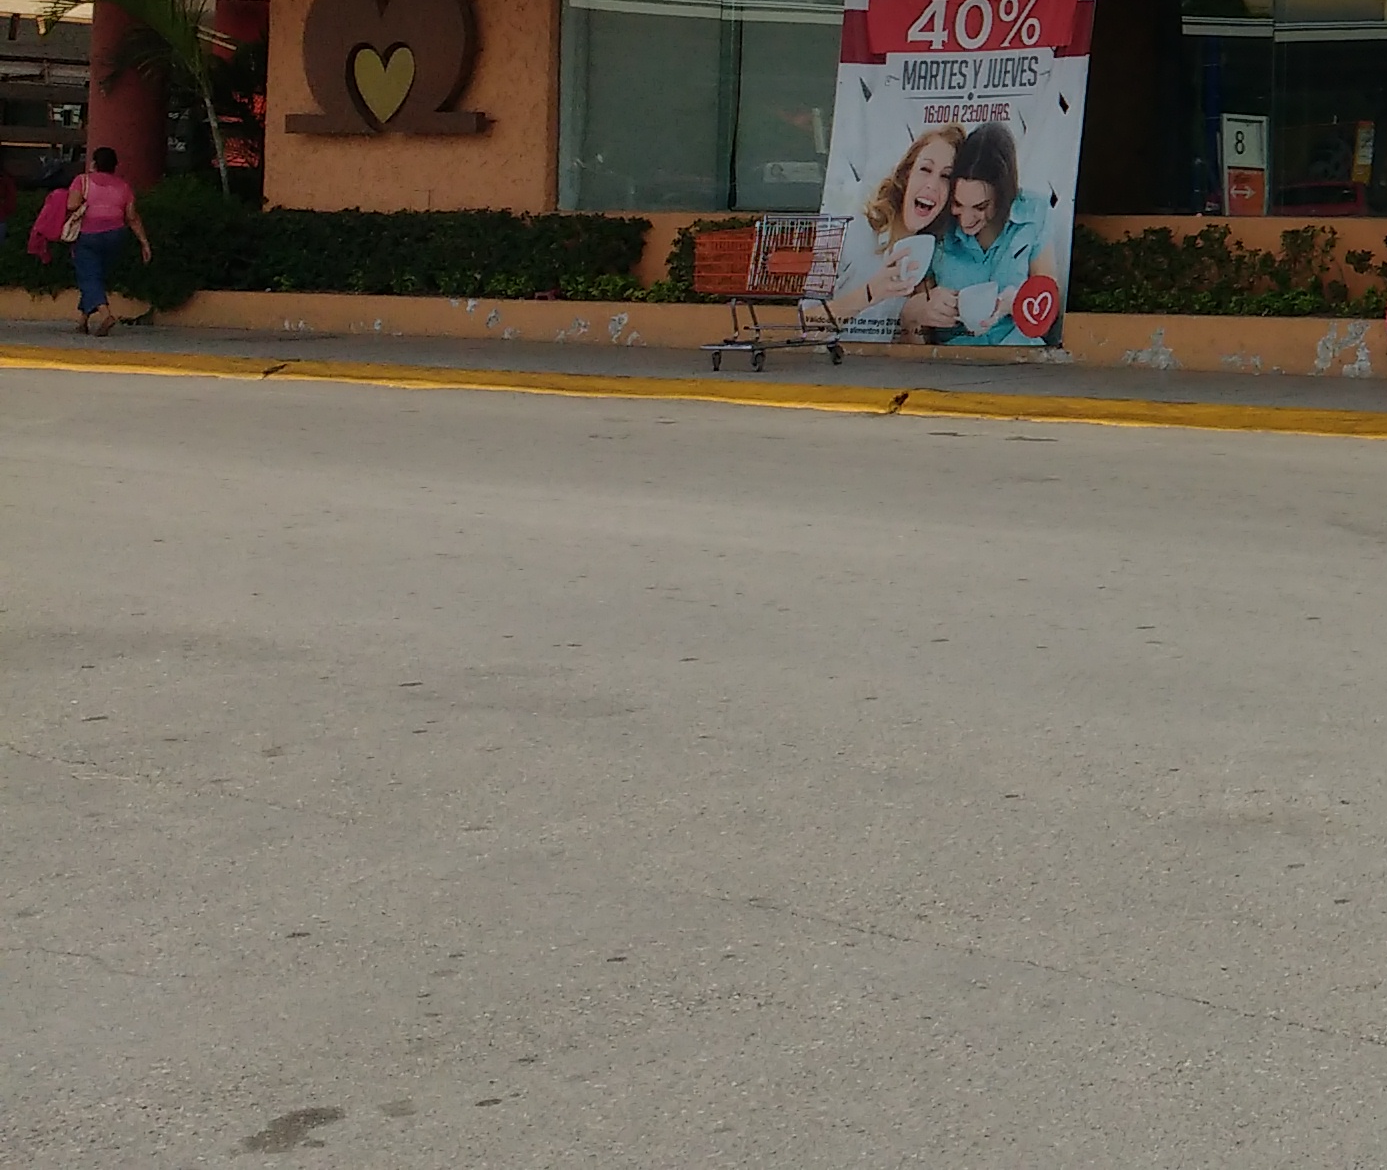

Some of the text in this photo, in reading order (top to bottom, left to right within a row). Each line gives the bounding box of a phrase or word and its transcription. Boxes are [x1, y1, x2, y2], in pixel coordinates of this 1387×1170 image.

[901, 56, 1039, 91] MARTES Y JUEVES
[923, 104, 950, 124] 16:00
[951, 104, 959, 123] A
[961, 103, 989, 123] 23:00
